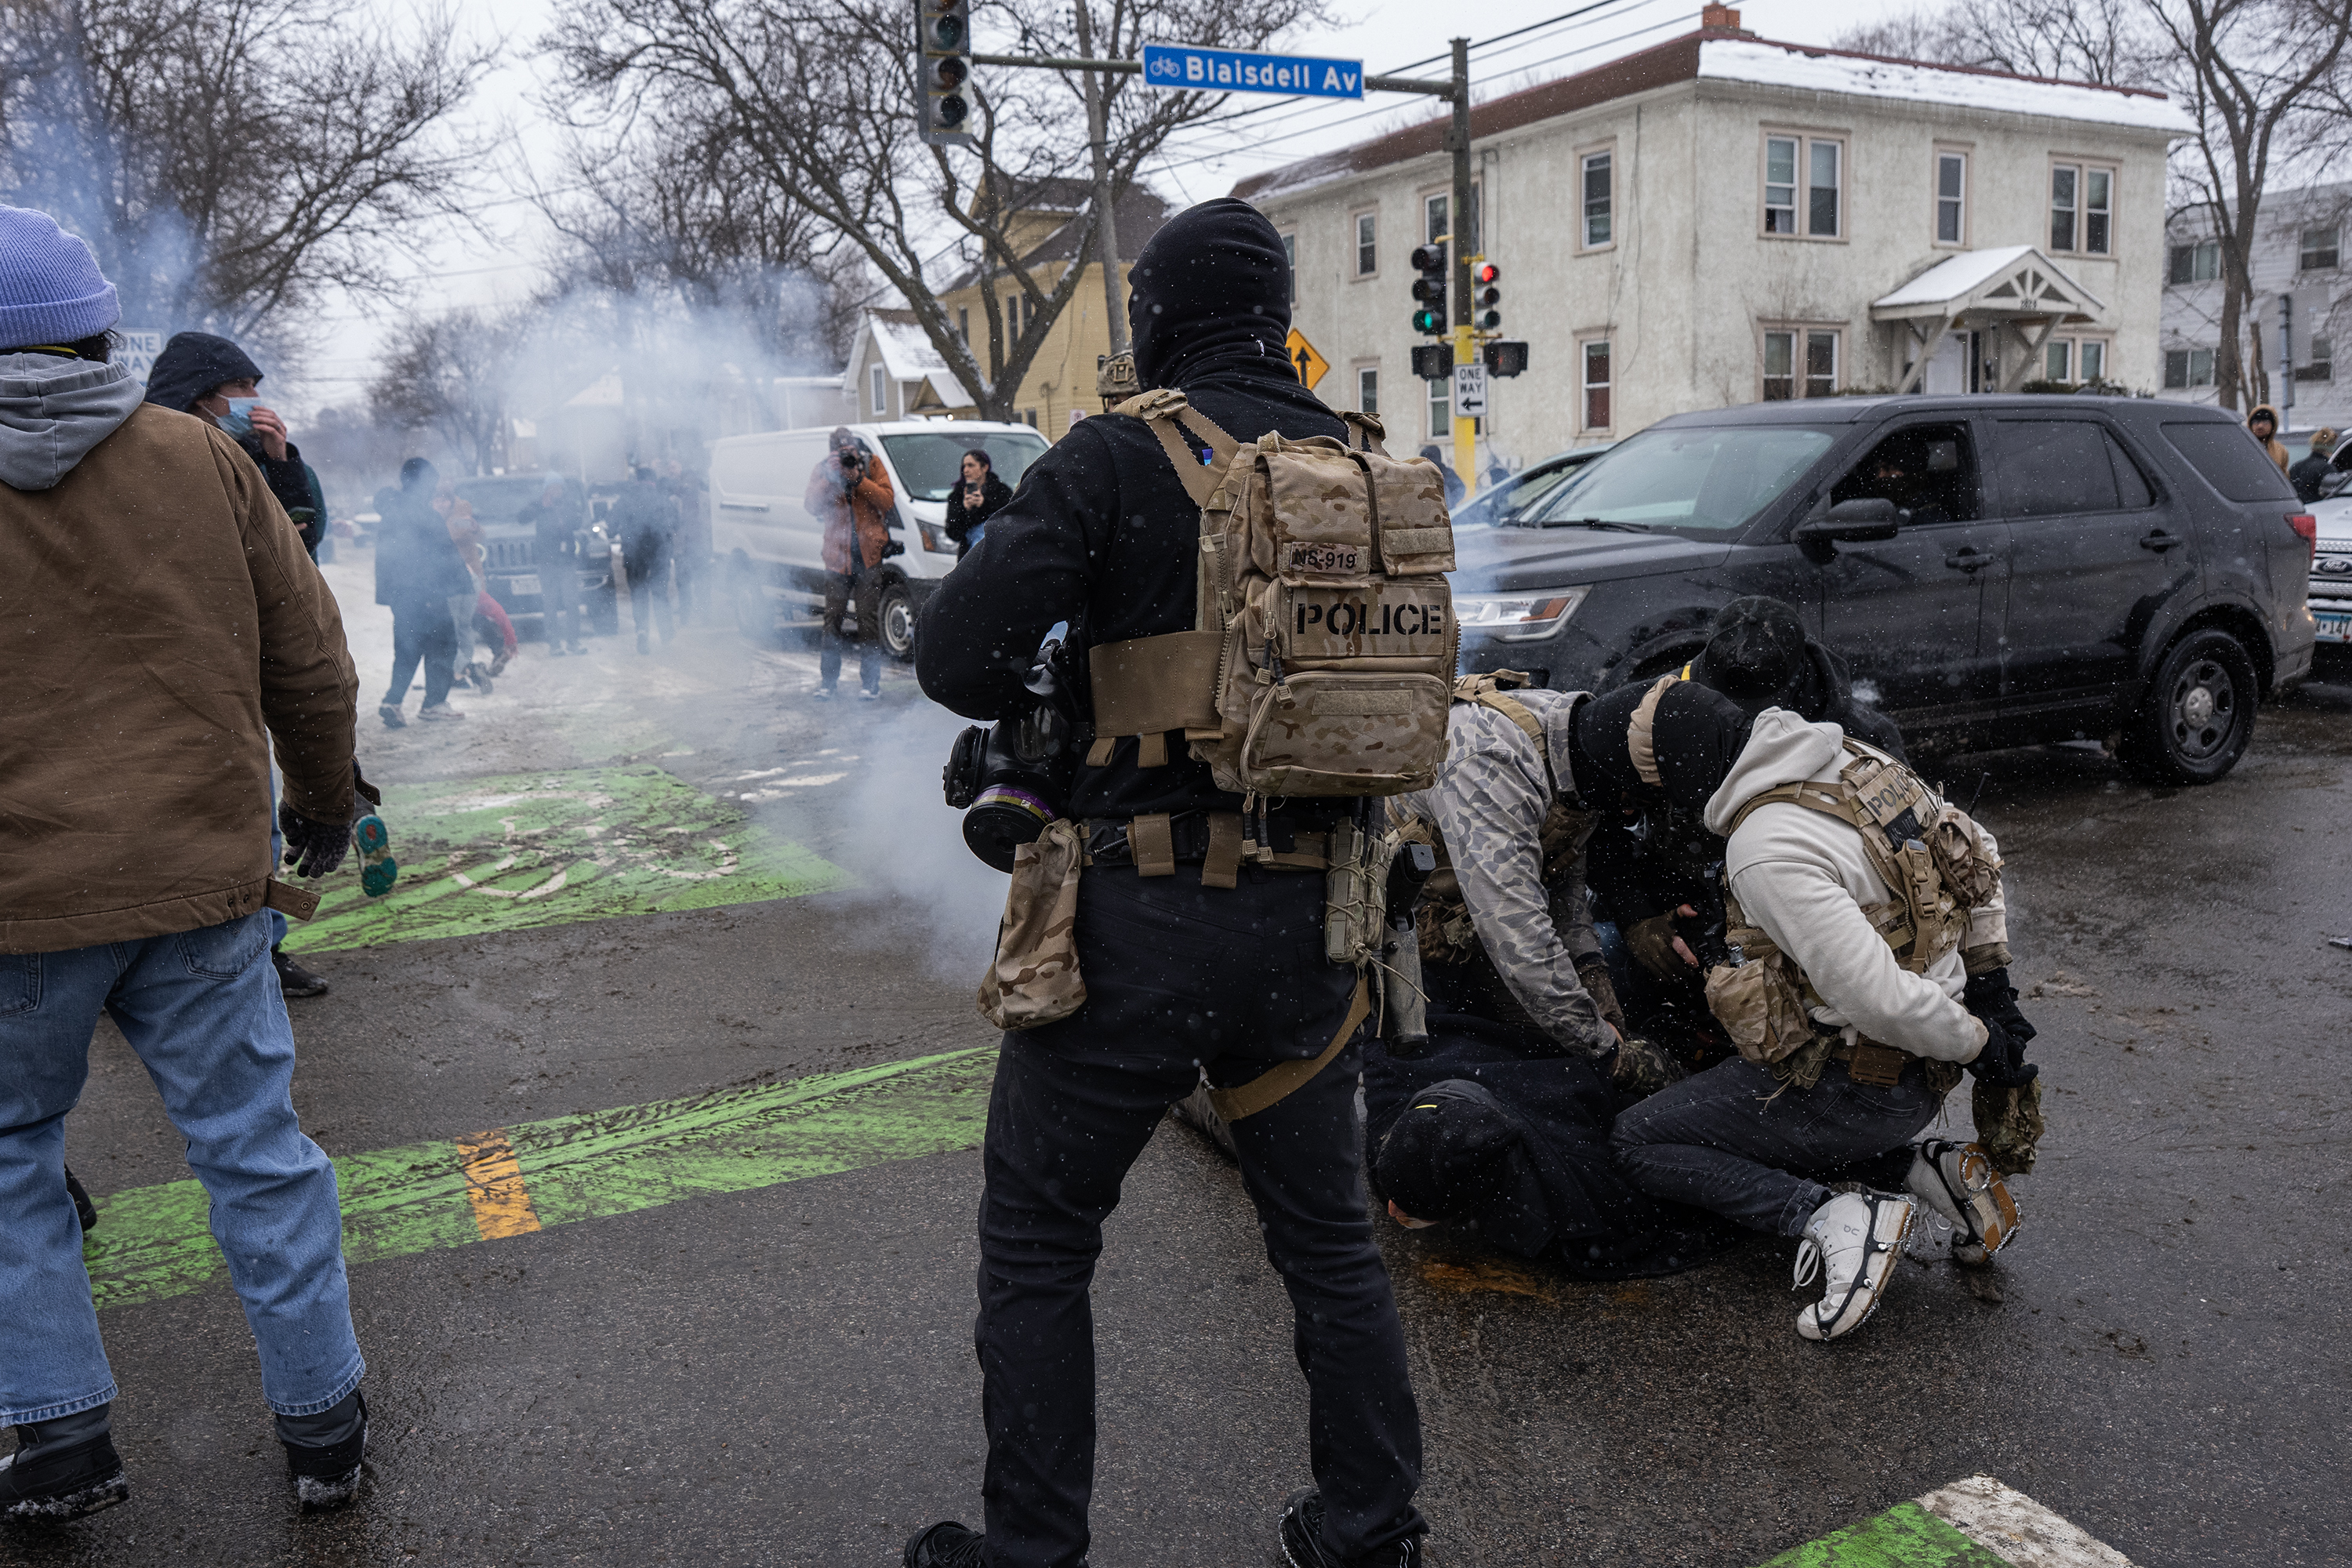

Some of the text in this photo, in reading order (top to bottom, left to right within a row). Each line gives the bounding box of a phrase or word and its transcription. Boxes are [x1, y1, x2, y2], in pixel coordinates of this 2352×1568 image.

[1186, 56, 1357, 93] Blaisdell Av
[1459, 368, 1482, 380] ONE
[1458, 383, 1483, 394] WAY
[1294, 548, 1356, 569] NS-919
[1297, 603, 1442, 636] POLICE
